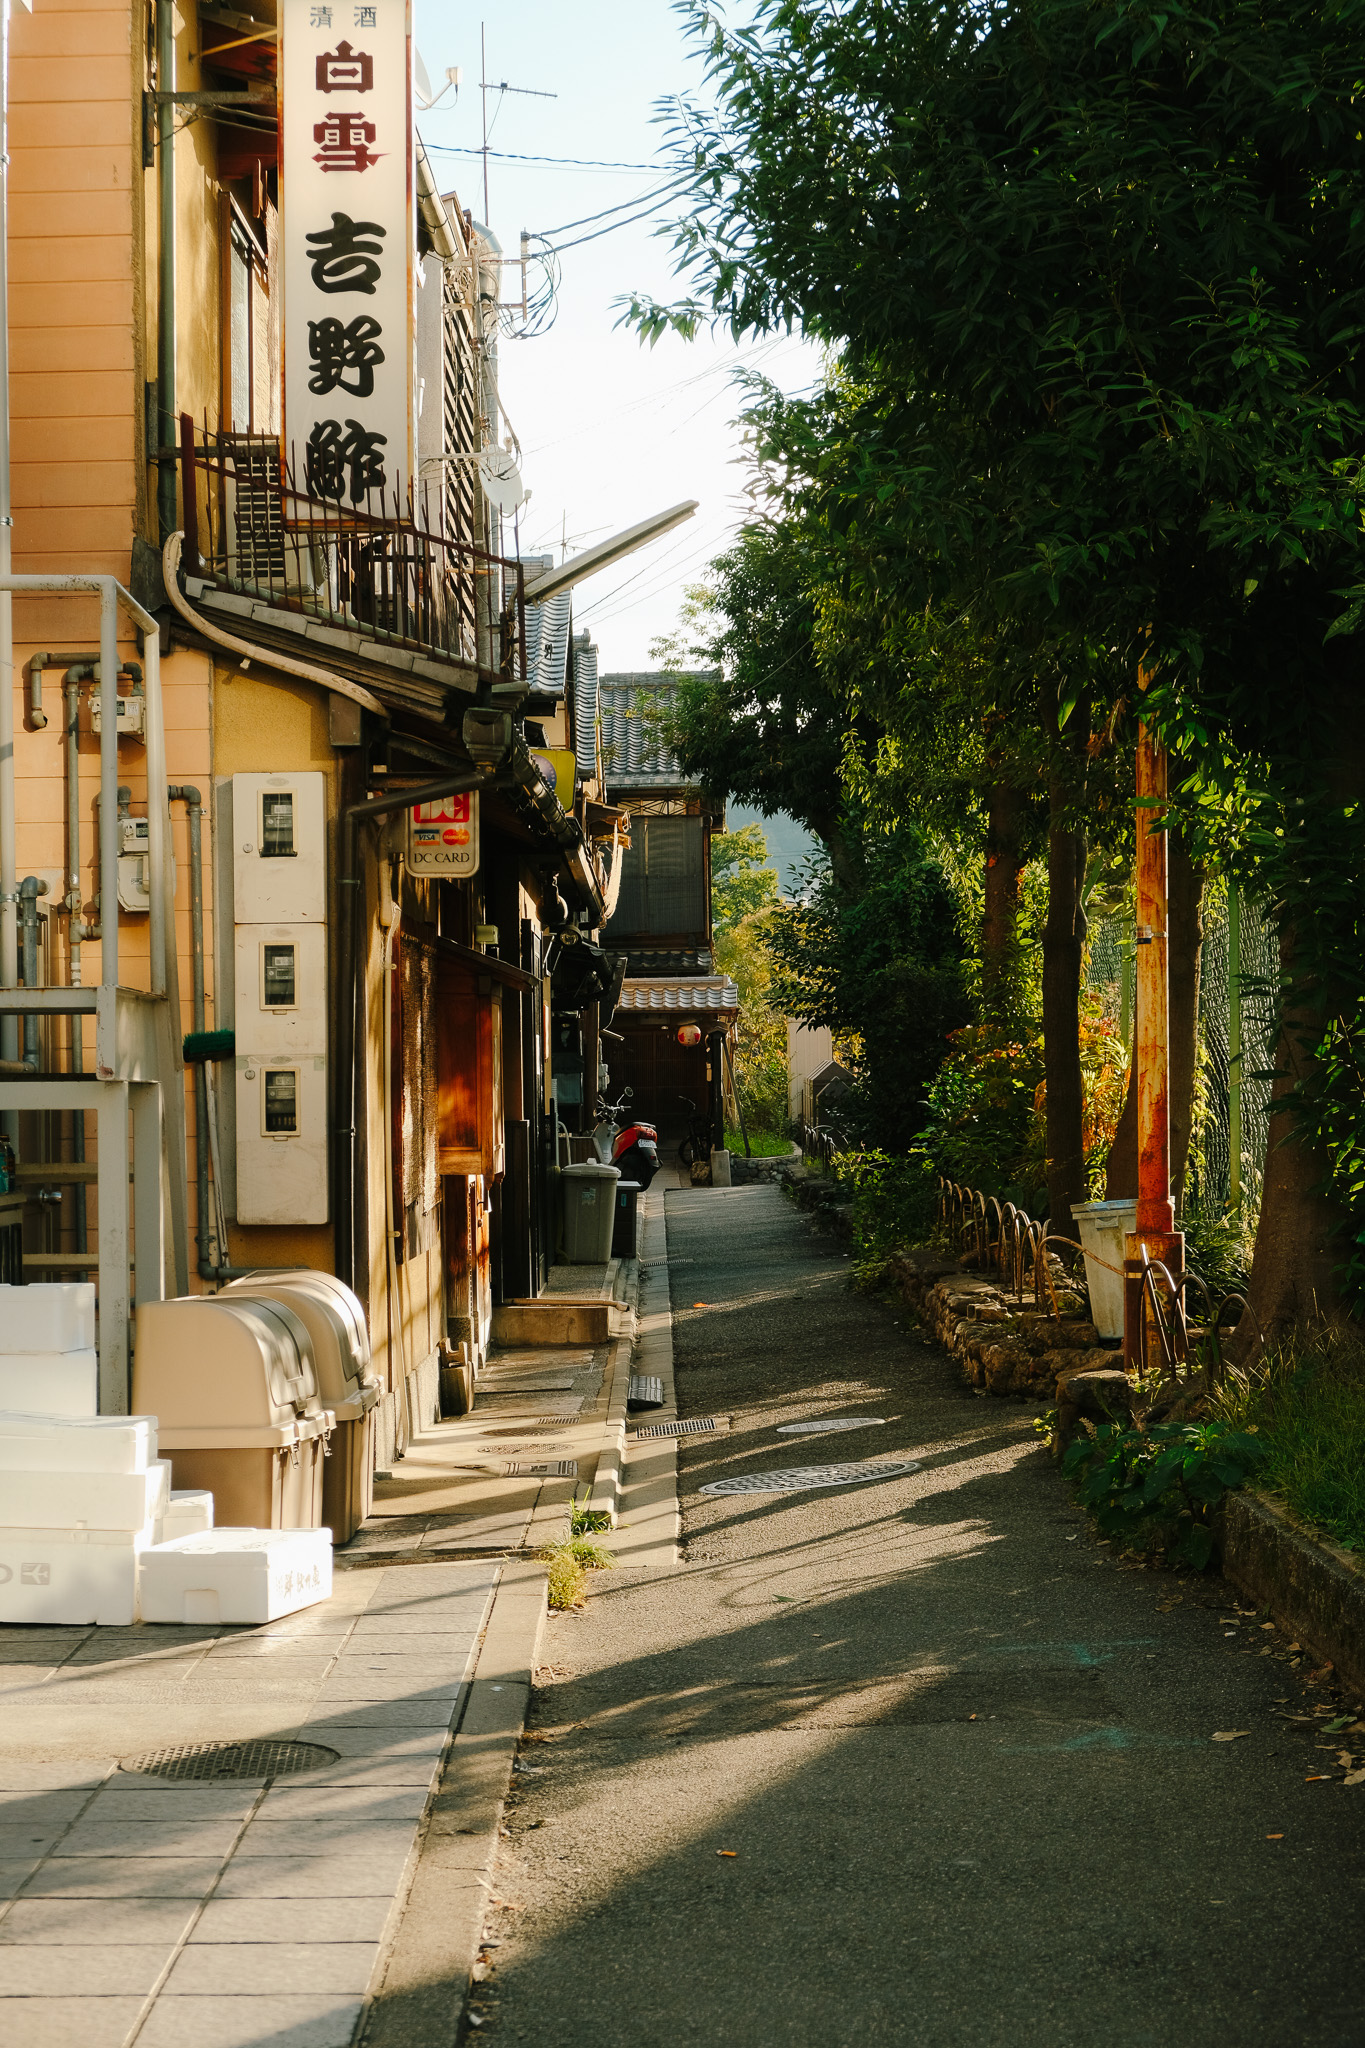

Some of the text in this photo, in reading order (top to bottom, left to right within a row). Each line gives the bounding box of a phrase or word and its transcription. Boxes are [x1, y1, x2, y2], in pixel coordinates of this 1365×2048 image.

[310, 6, 377, 28] 清酒
[312, 40, 389, 174] 白雪
[414, 853, 469, 863] DC CARD
